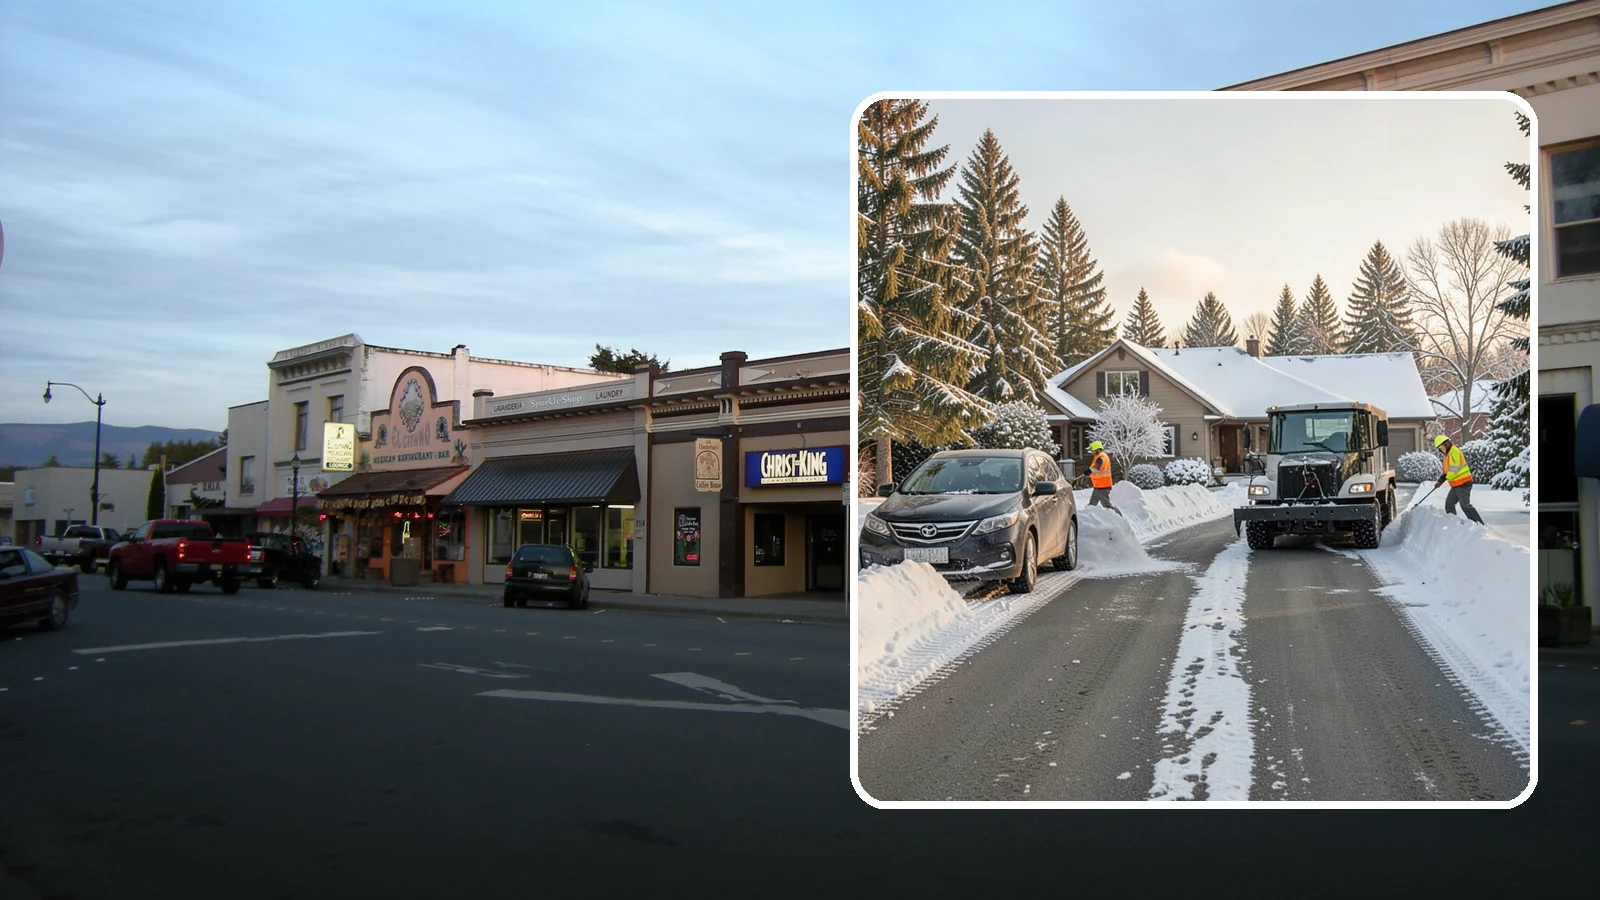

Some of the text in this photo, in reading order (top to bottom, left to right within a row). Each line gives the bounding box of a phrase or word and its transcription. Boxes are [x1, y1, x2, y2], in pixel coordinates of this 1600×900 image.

[493, 389, 623, 412] LAVANDERIA Sparkle Shop LAUNDRY
[373, 455, 396, 464] MEXICAN
[397, 452, 433, 462] RESTAURANT
[438, 450, 450, 459] BAR
[760, 450, 827, 478] CHRIST KING
